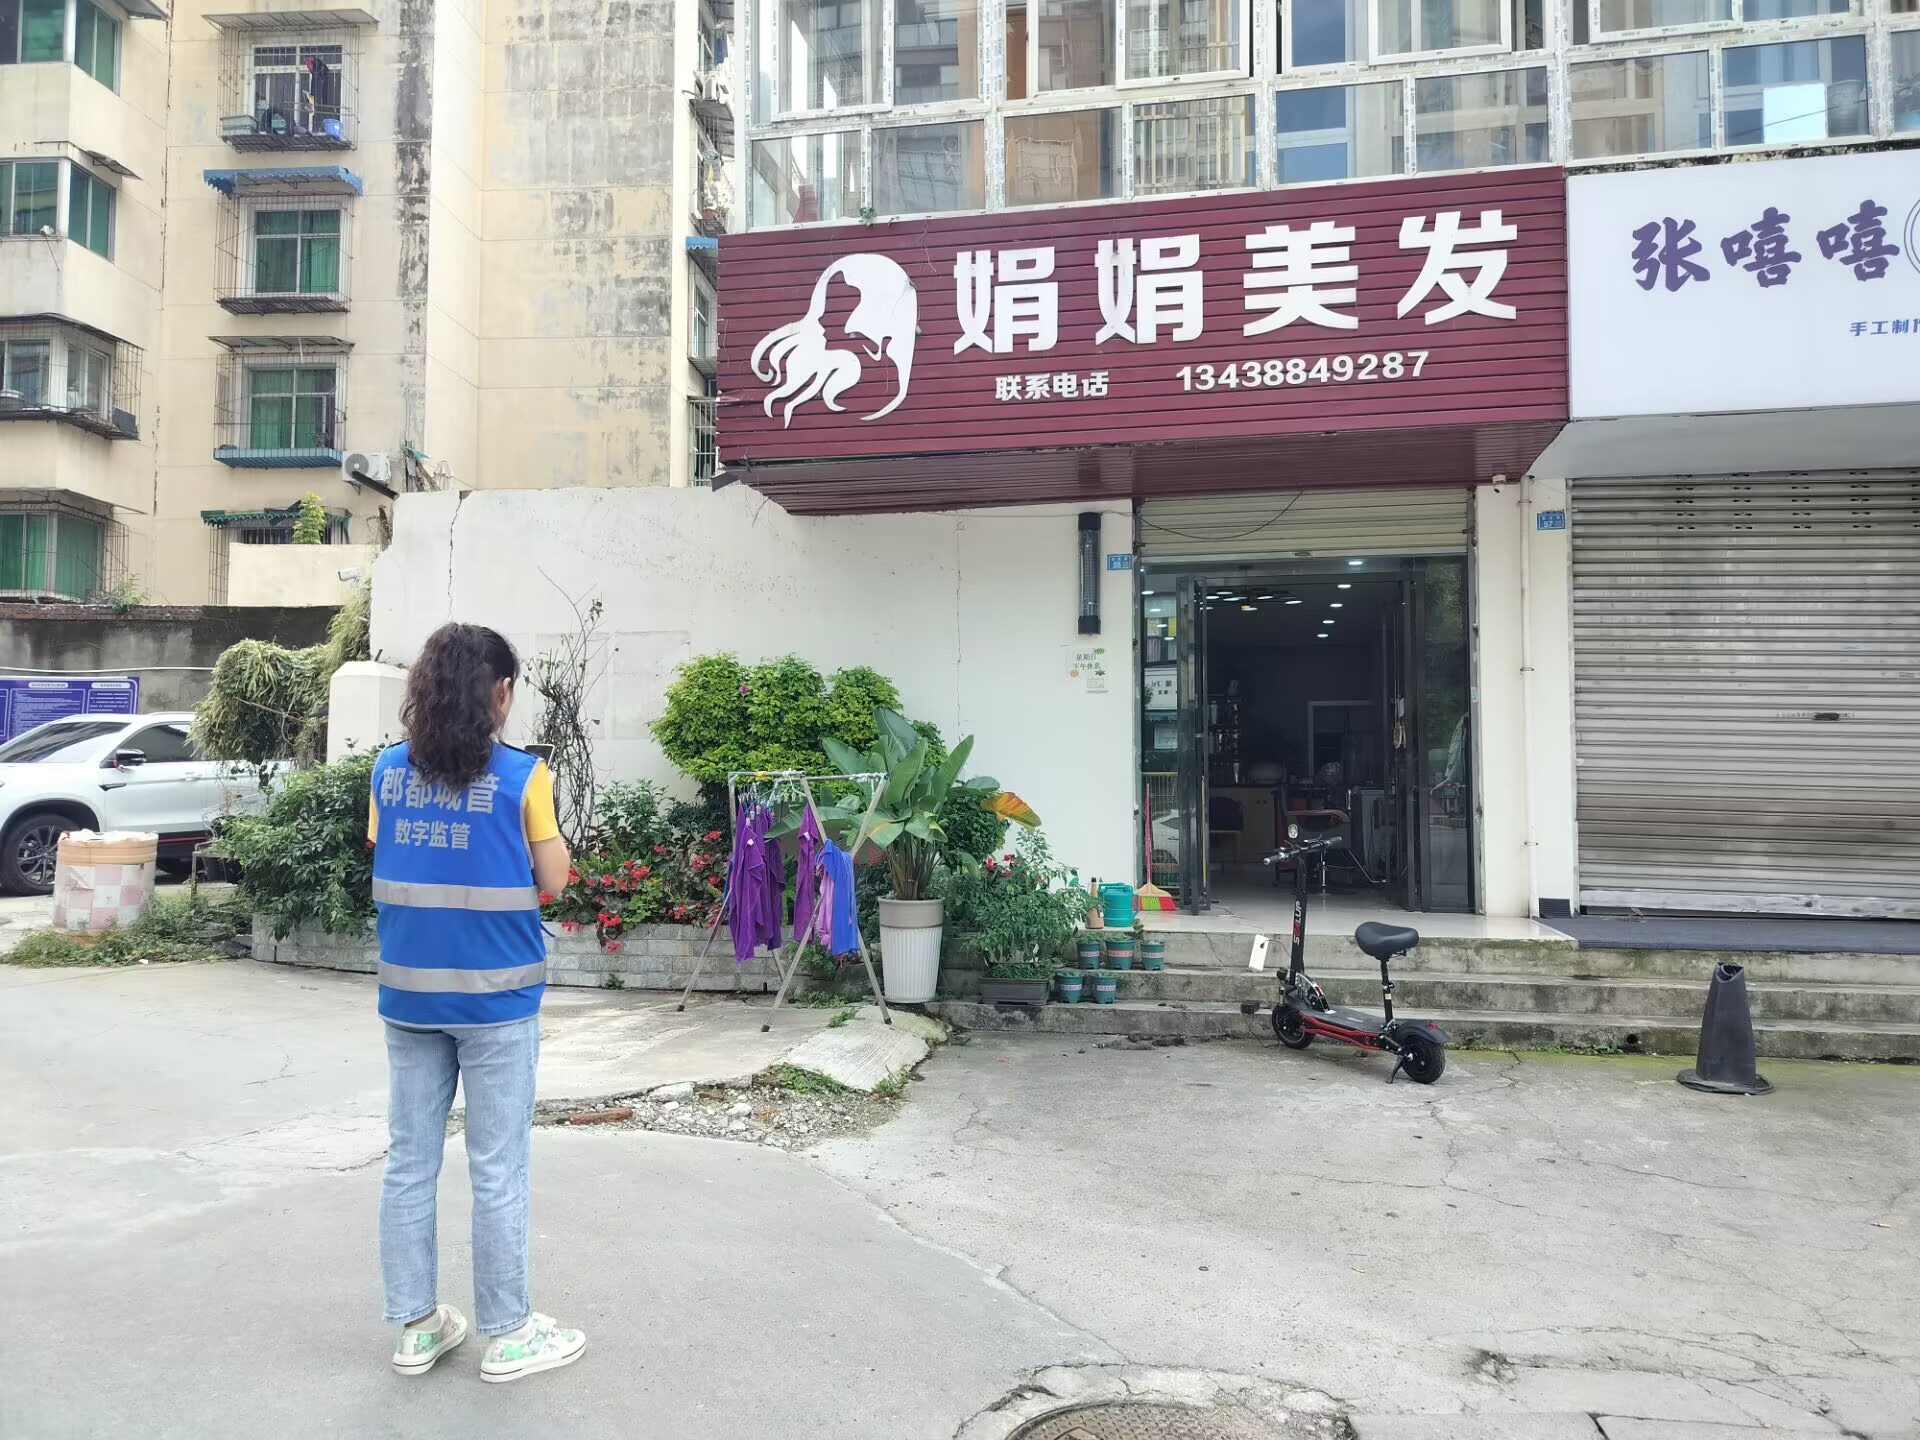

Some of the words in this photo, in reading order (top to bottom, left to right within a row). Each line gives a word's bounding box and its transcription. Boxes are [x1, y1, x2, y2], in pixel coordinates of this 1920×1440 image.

[1632, 199, 1900, 292] 张嘻嘻
[954, 208, 1518, 355] 娟娟美发
[995, 370, 1110, 402] 联系电话
[1176, 350, 1430, 392] 13438849287
[394, 817, 471, 850] 数字监管
